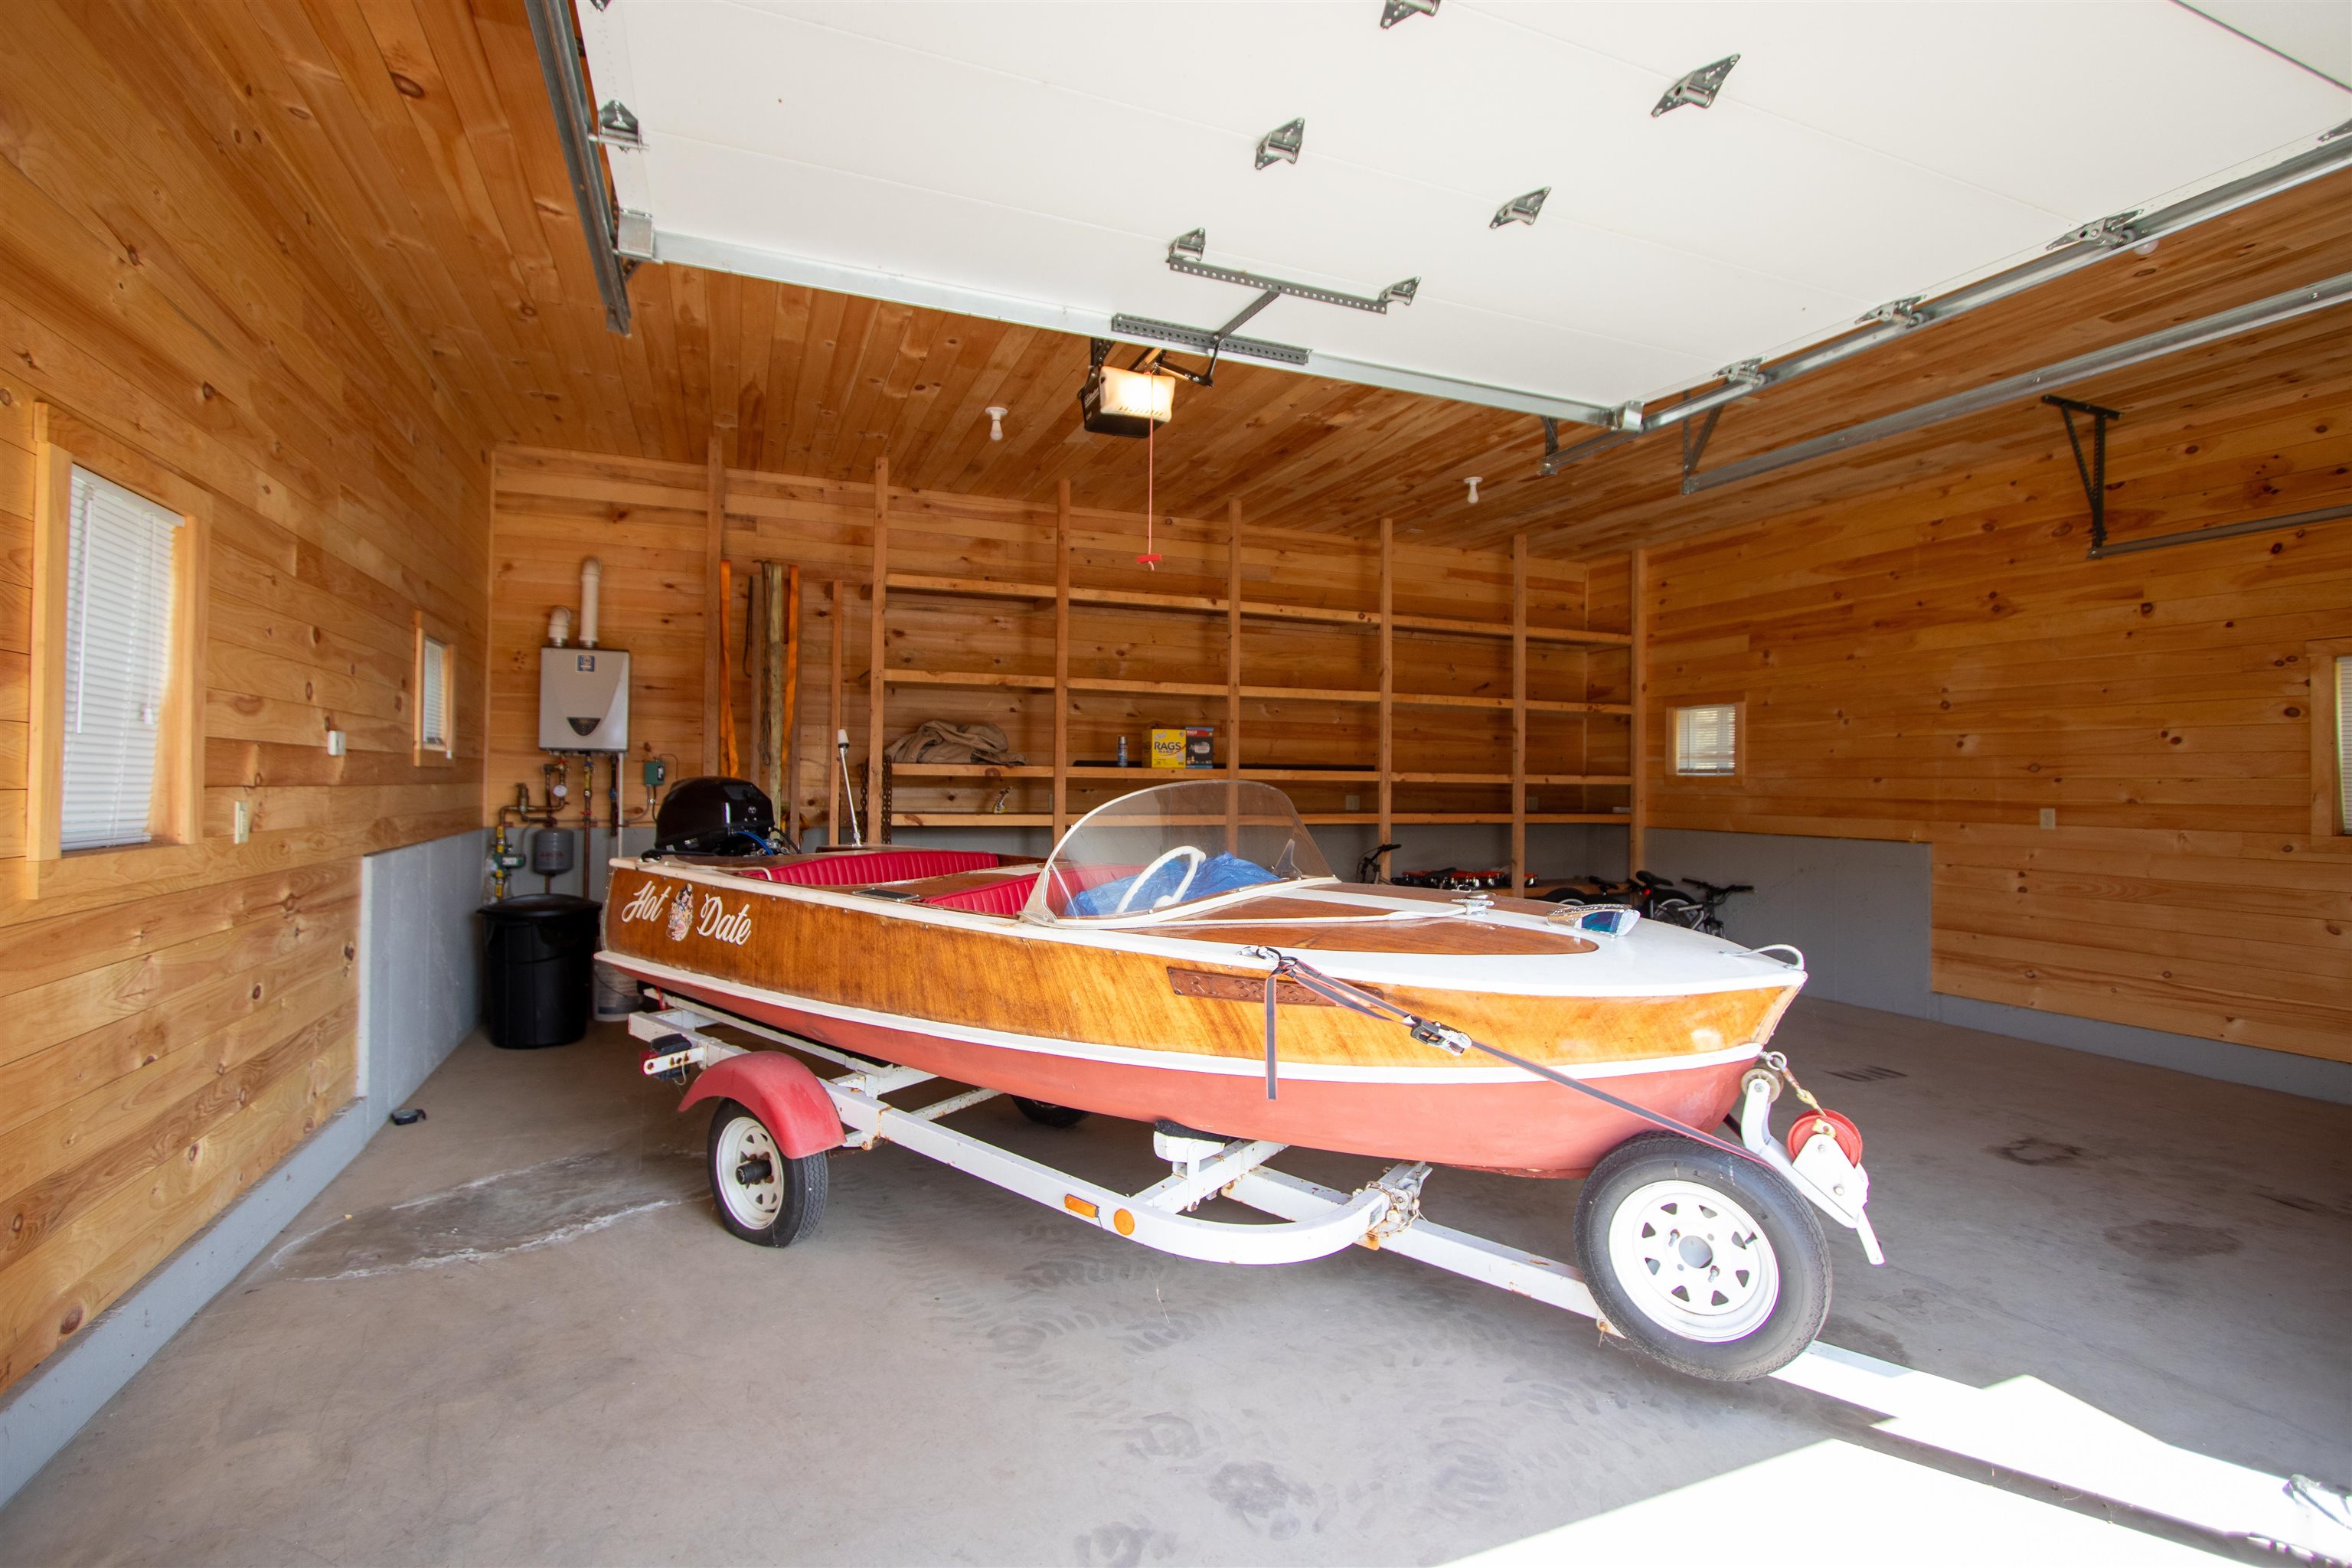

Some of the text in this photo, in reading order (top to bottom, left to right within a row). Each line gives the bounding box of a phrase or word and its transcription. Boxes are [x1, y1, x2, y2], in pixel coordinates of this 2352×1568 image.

[1154, 741, 1181, 750] RAGS
[621, 880, 752, 946] Hot Date
